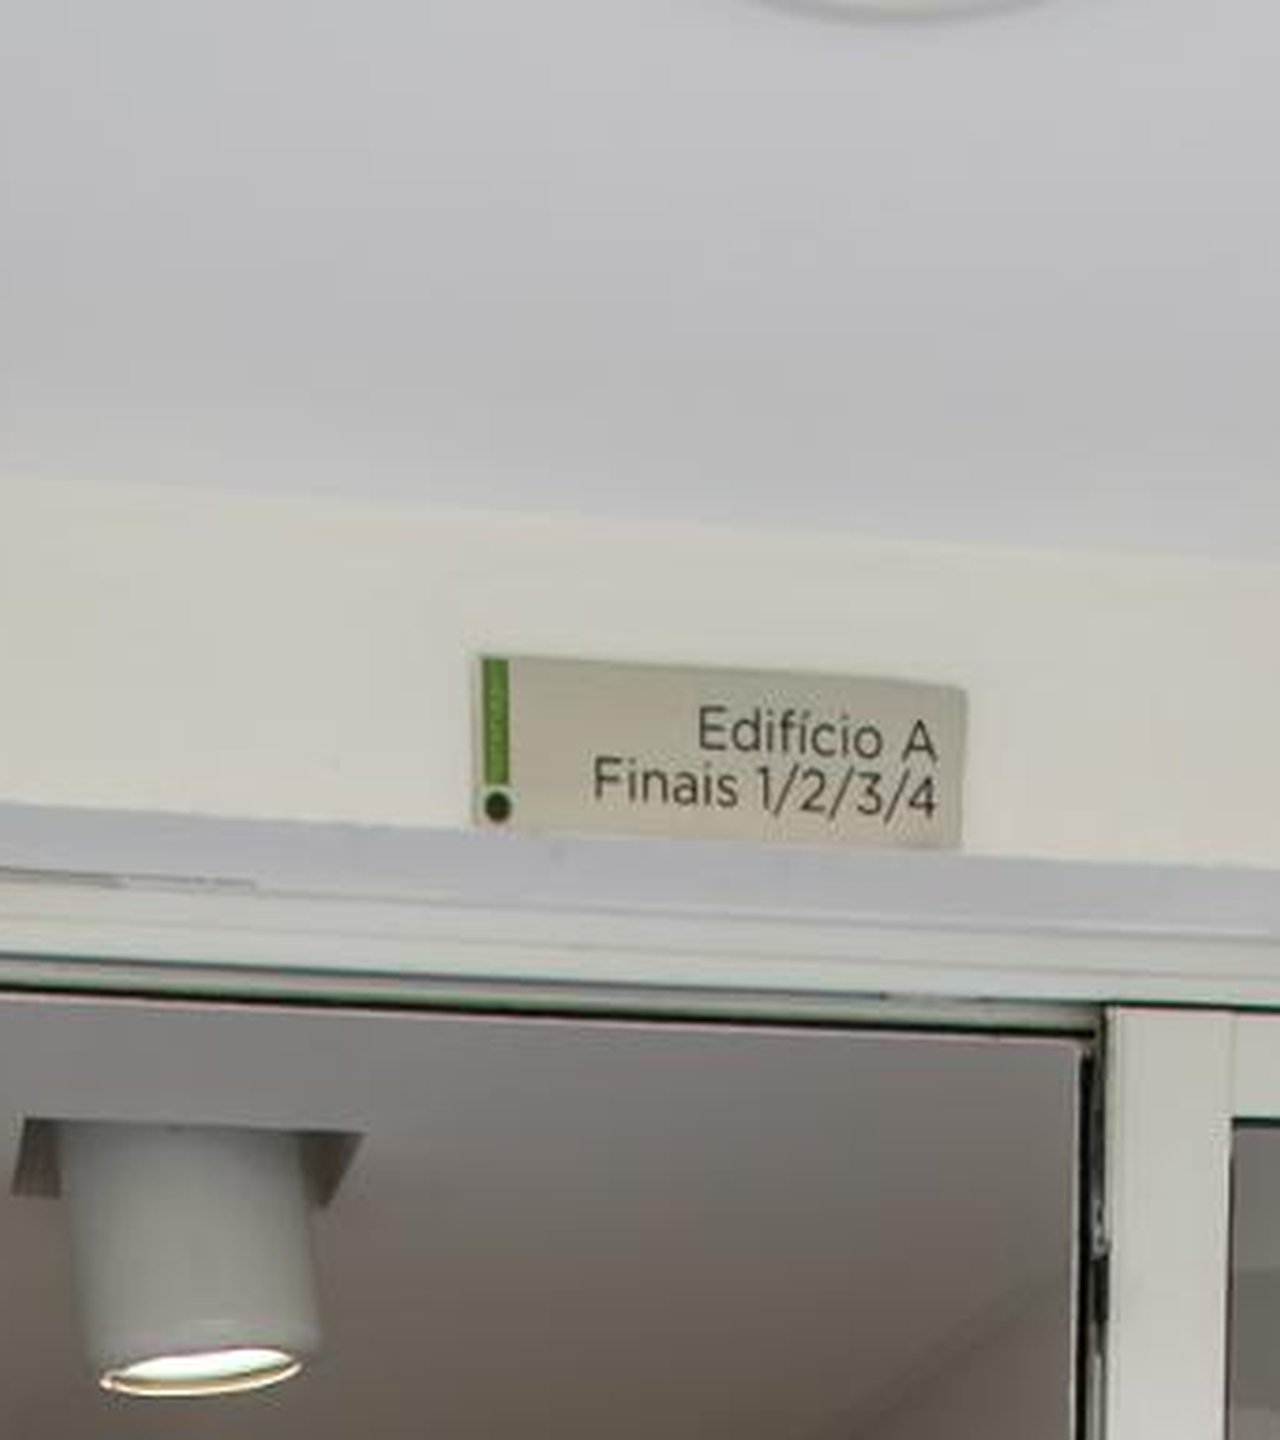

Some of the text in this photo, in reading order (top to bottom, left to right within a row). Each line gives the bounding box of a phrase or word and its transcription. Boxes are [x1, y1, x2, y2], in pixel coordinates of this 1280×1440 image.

[699, 704, 938, 763] Edifício A
[594, 756, 938, 825] Finais 1/2/3/4
